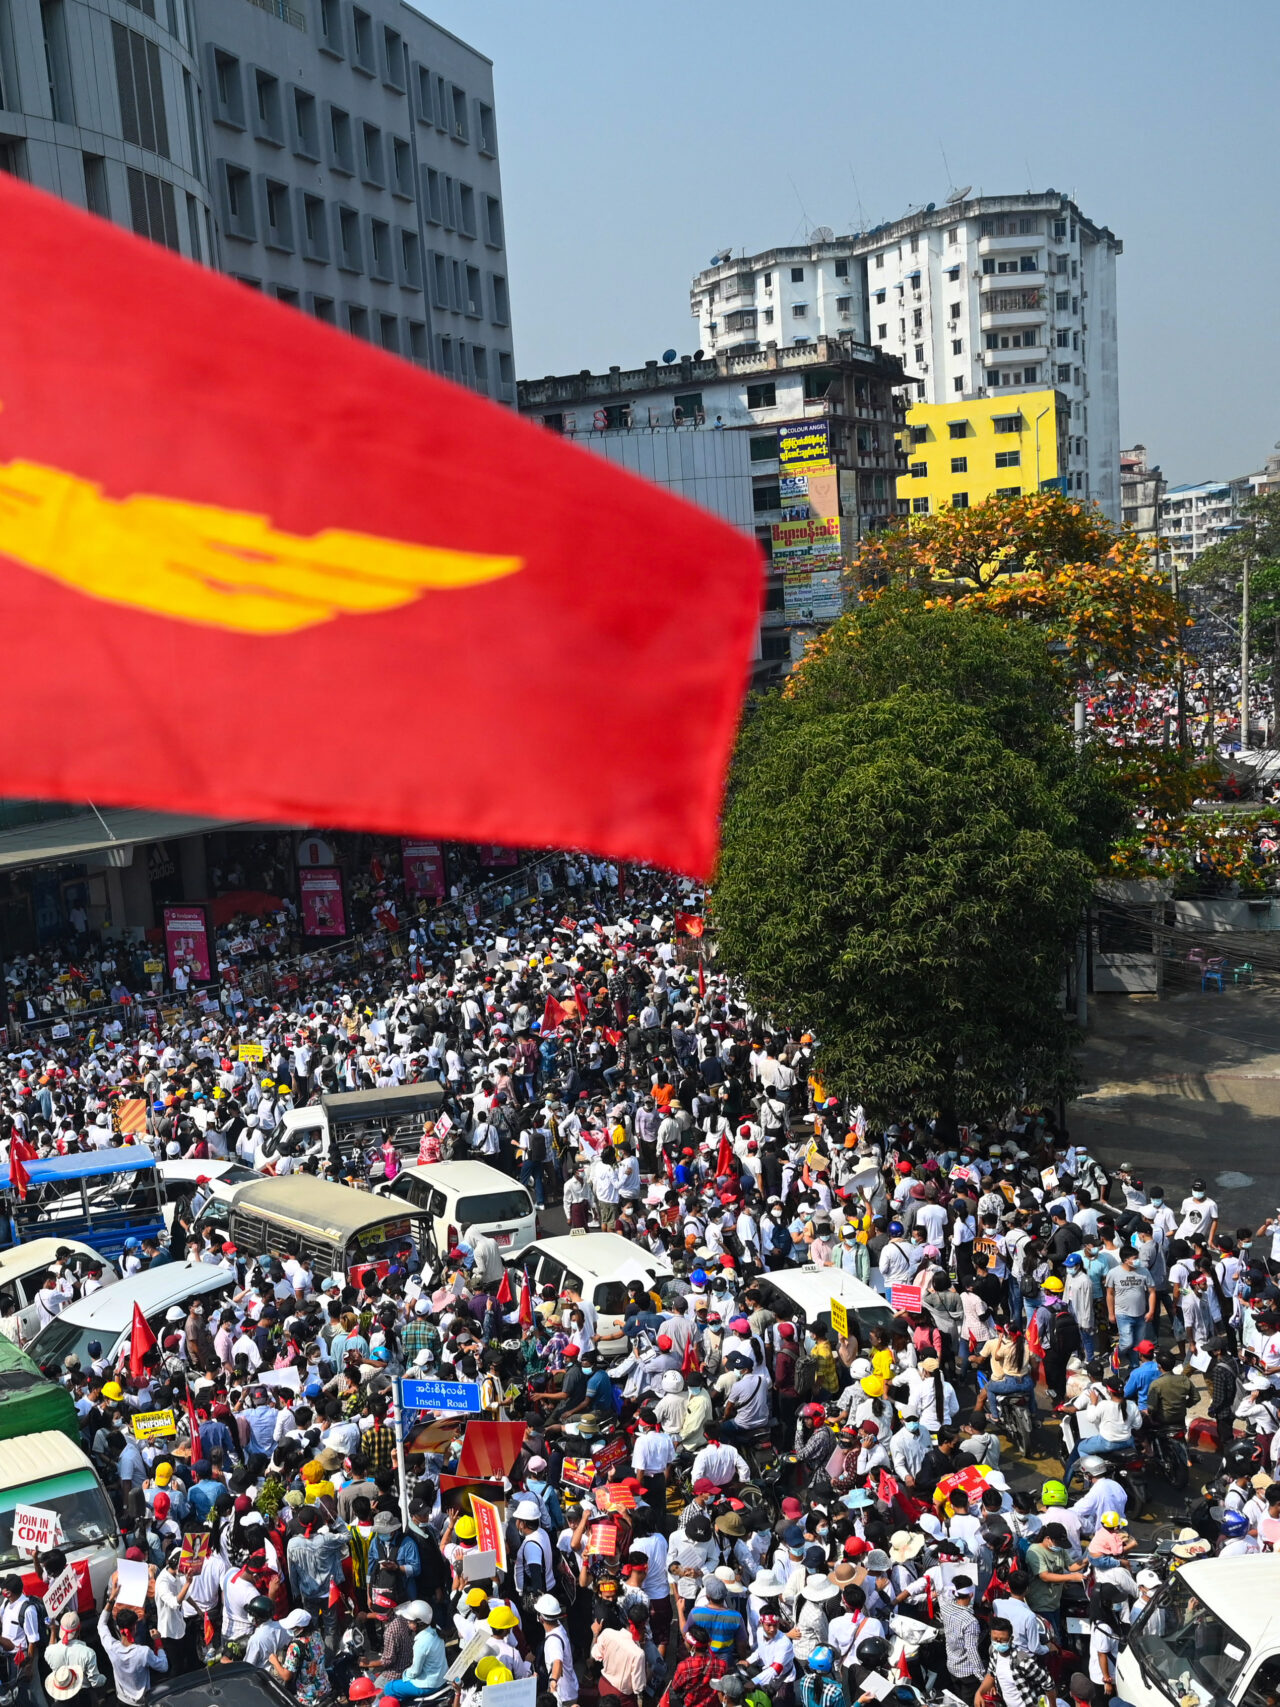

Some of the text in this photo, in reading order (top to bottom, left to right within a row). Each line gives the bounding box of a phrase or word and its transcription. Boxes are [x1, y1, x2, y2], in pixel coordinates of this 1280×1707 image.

[780, 476, 808, 486] LCCI
[416, 1383, 467, 1397] အင်းစိန်လမ်း
[416, 1397, 468, 1408] Insein Road
[137, 1418, 172, 1430] UNIFORM
[947, 1471, 968, 1485] HELP US
[16, 1512, 49, 1530] "JOIN IN
[482, 1508, 489, 1525] UN
[18, 1527, 53, 1545] CDM"
[61, 1573, 70, 1587] IN
